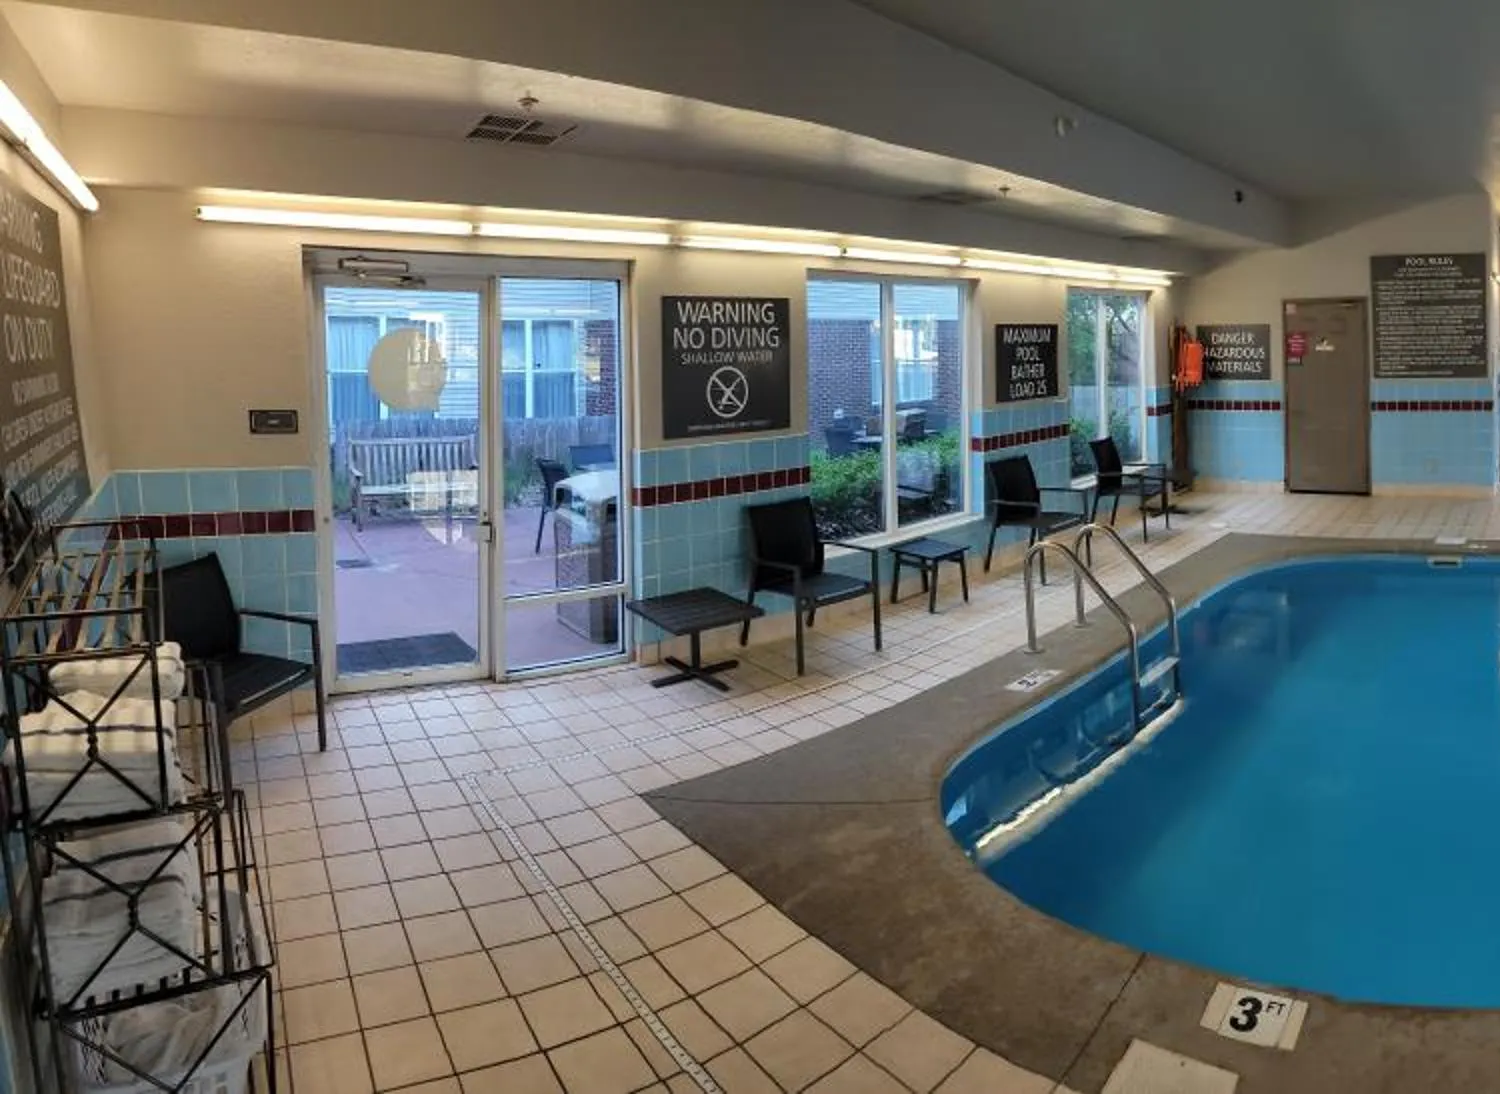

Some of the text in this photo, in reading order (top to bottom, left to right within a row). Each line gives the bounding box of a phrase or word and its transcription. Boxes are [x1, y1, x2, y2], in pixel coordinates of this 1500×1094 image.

[677, 301, 775, 324] WARNING
[673, 327, 780, 349] NO DIVING
[1003, 327, 1051, 344] MAXIMUM
[1211, 331, 1256, 345] DANGER
[681, 350, 773, 365] SHALLOW WATER
[1016, 346, 1041, 361] POOL
[1009, 381, 1035, 399] LOAD
[1229, 996, 1286, 1032] 3 FT
